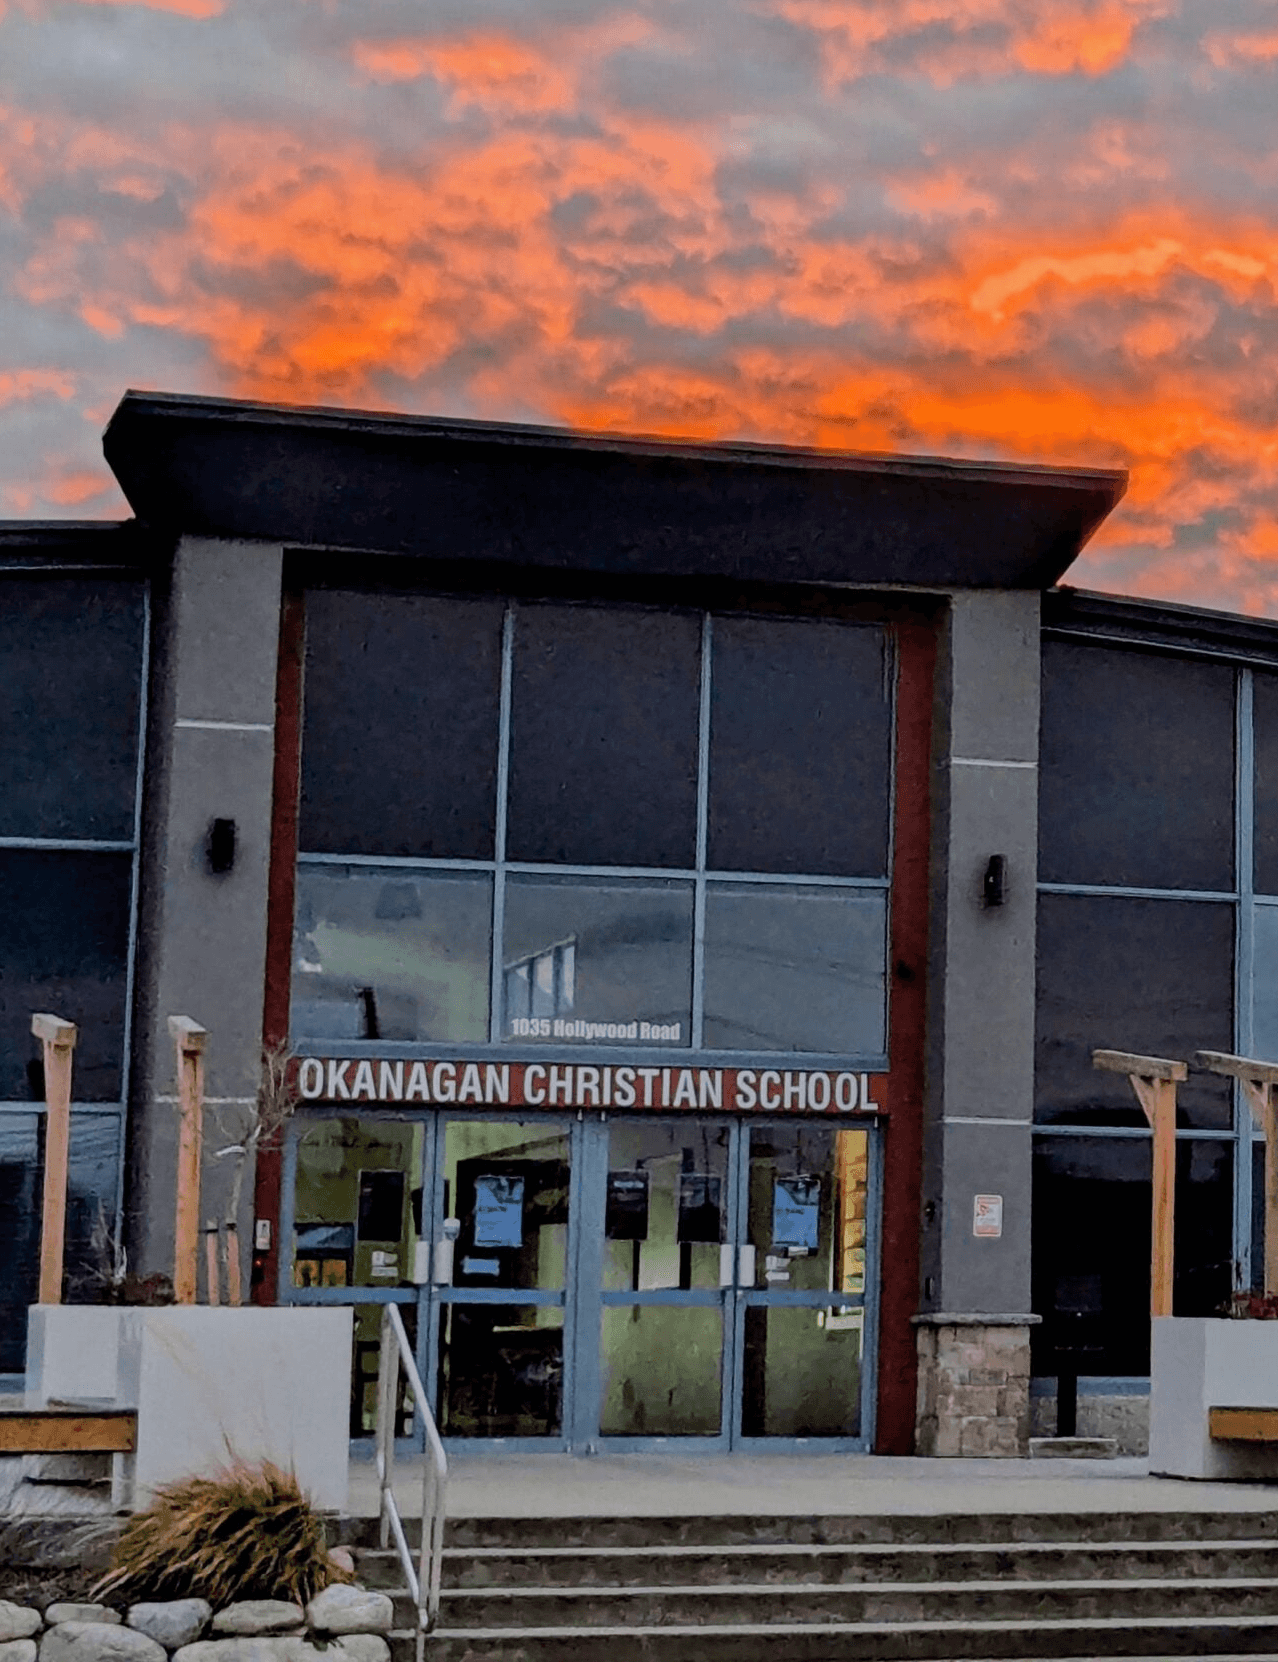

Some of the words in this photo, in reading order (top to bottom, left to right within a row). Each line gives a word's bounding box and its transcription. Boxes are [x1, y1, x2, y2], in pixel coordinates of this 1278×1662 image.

[511, 1018, 550, 1036] 1035
[553, 1019, 637, 1040] Hollywood
[639, 1021, 681, 1040] Road
[301, 1058, 509, 1103] OKANAGAN
[523, 1064, 722, 1108] CHRISTIAN
[735, 1070, 879, 1111] SCHOOL
